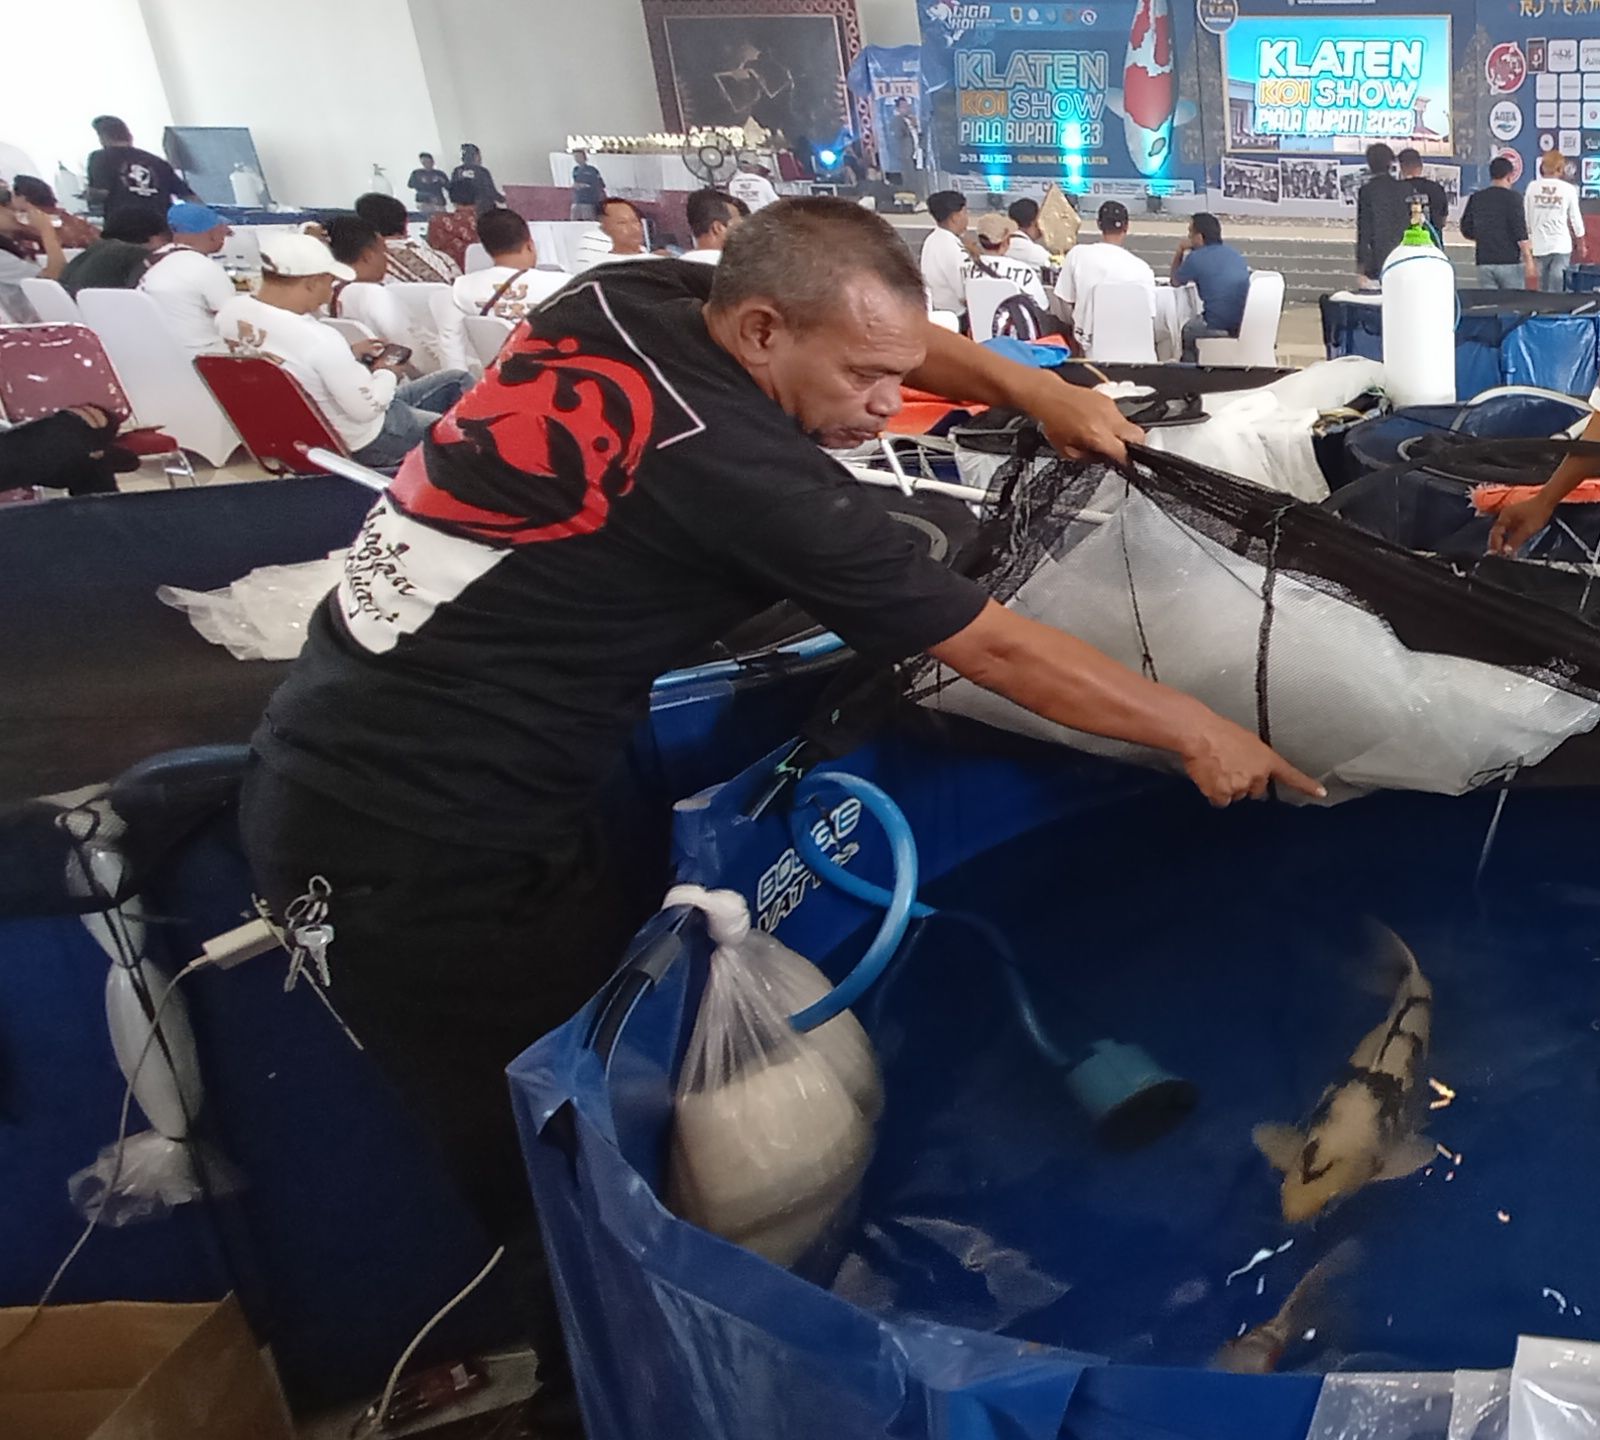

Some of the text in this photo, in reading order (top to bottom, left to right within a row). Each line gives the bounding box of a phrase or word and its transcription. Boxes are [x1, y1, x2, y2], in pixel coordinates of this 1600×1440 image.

[951, 18, 975, 29] KOI
[953, 5, 990, 18] LIGA
[957, 53, 1105, 89] KLATEN
[1259, 40, 1422, 78] KLATEN
[959, 91, 1104, 119] KOI SHOW
[1260, 79, 1417, 107] KOI SHOW
[960, 121, 1001, 143] PIALA
[1005, 122, 1056, 143] BUPATI
[1259, 110, 1412, 134] PIALA BUPATI 2023
[1006, 267, 1033, 286] LTD
